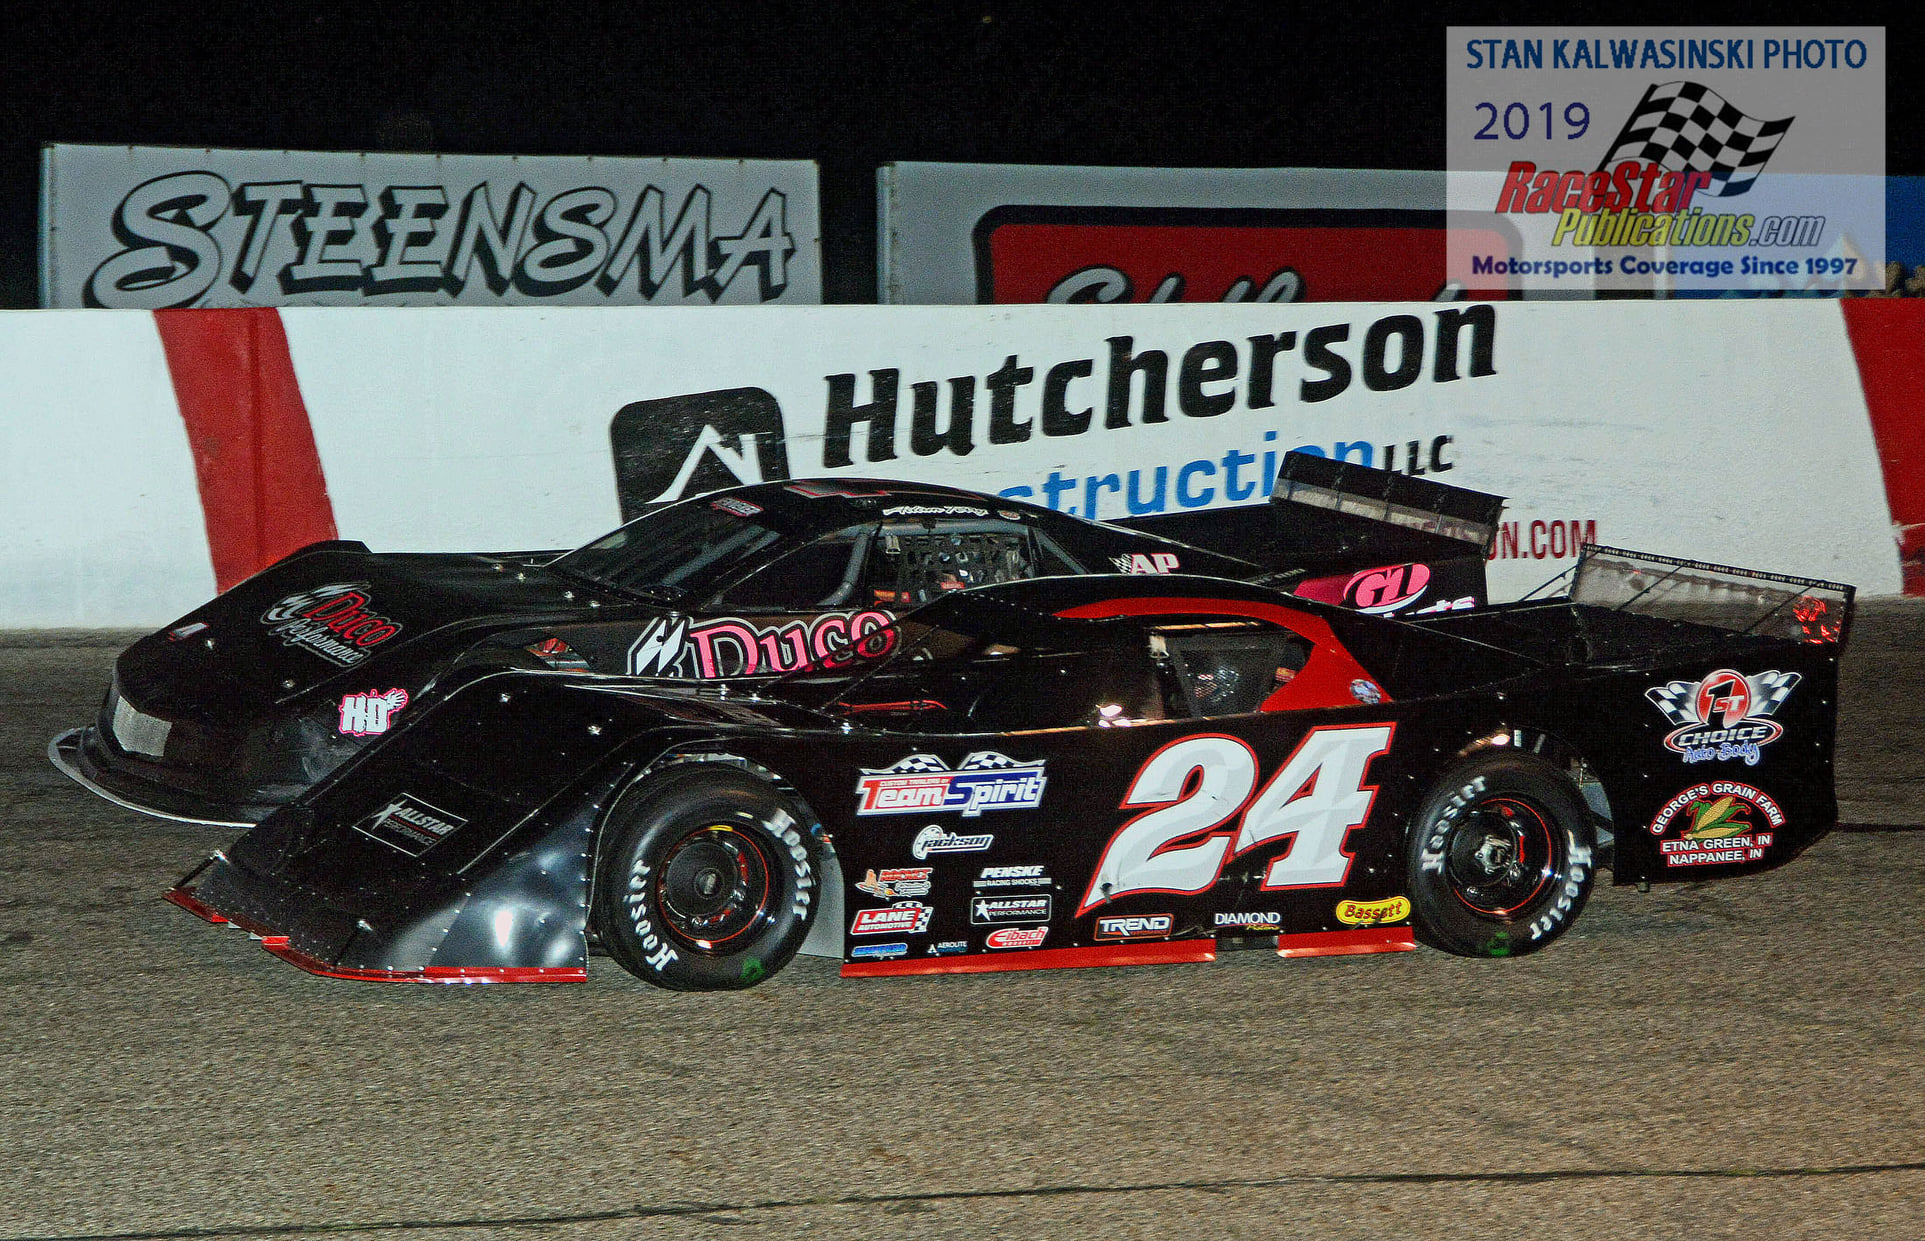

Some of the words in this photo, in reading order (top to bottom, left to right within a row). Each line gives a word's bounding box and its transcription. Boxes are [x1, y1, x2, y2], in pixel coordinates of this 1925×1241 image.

[82, 170, 796, 308] STEENSMA
[823, 303, 1498, 468] Hutcherson
[688, 610, 896, 678] Duco
[1677, 726, 1768, 748] CHOICE
[1682, 746, 1717, 764] Auto
[1717, 739, 1761, 766] Body
[1652, 785, 1710, 834] GEORGE'S
[1712, 782, 1757, 801] GRAIN
[1756, 795, 1784, 827] FARM
[1075, 721, 1397, 918] 24
[1662, 839, 1700, 853] ETNA
[1757, 834, 1771, 846] IN
[1749, 847, 1763, 859] IN
[980, 865, 1044, 879] PENSKE
[989, 899, 1047, 910] ALLSTAR
[1344, 900, 1403, 920] Bassett
[859, 910, 914, 924] LANE
[1099, 916, 1170, 936] TREND
[1214, 912, 1281, 925] DIAMOND
[993, 929, 1046, 946] Eibach
